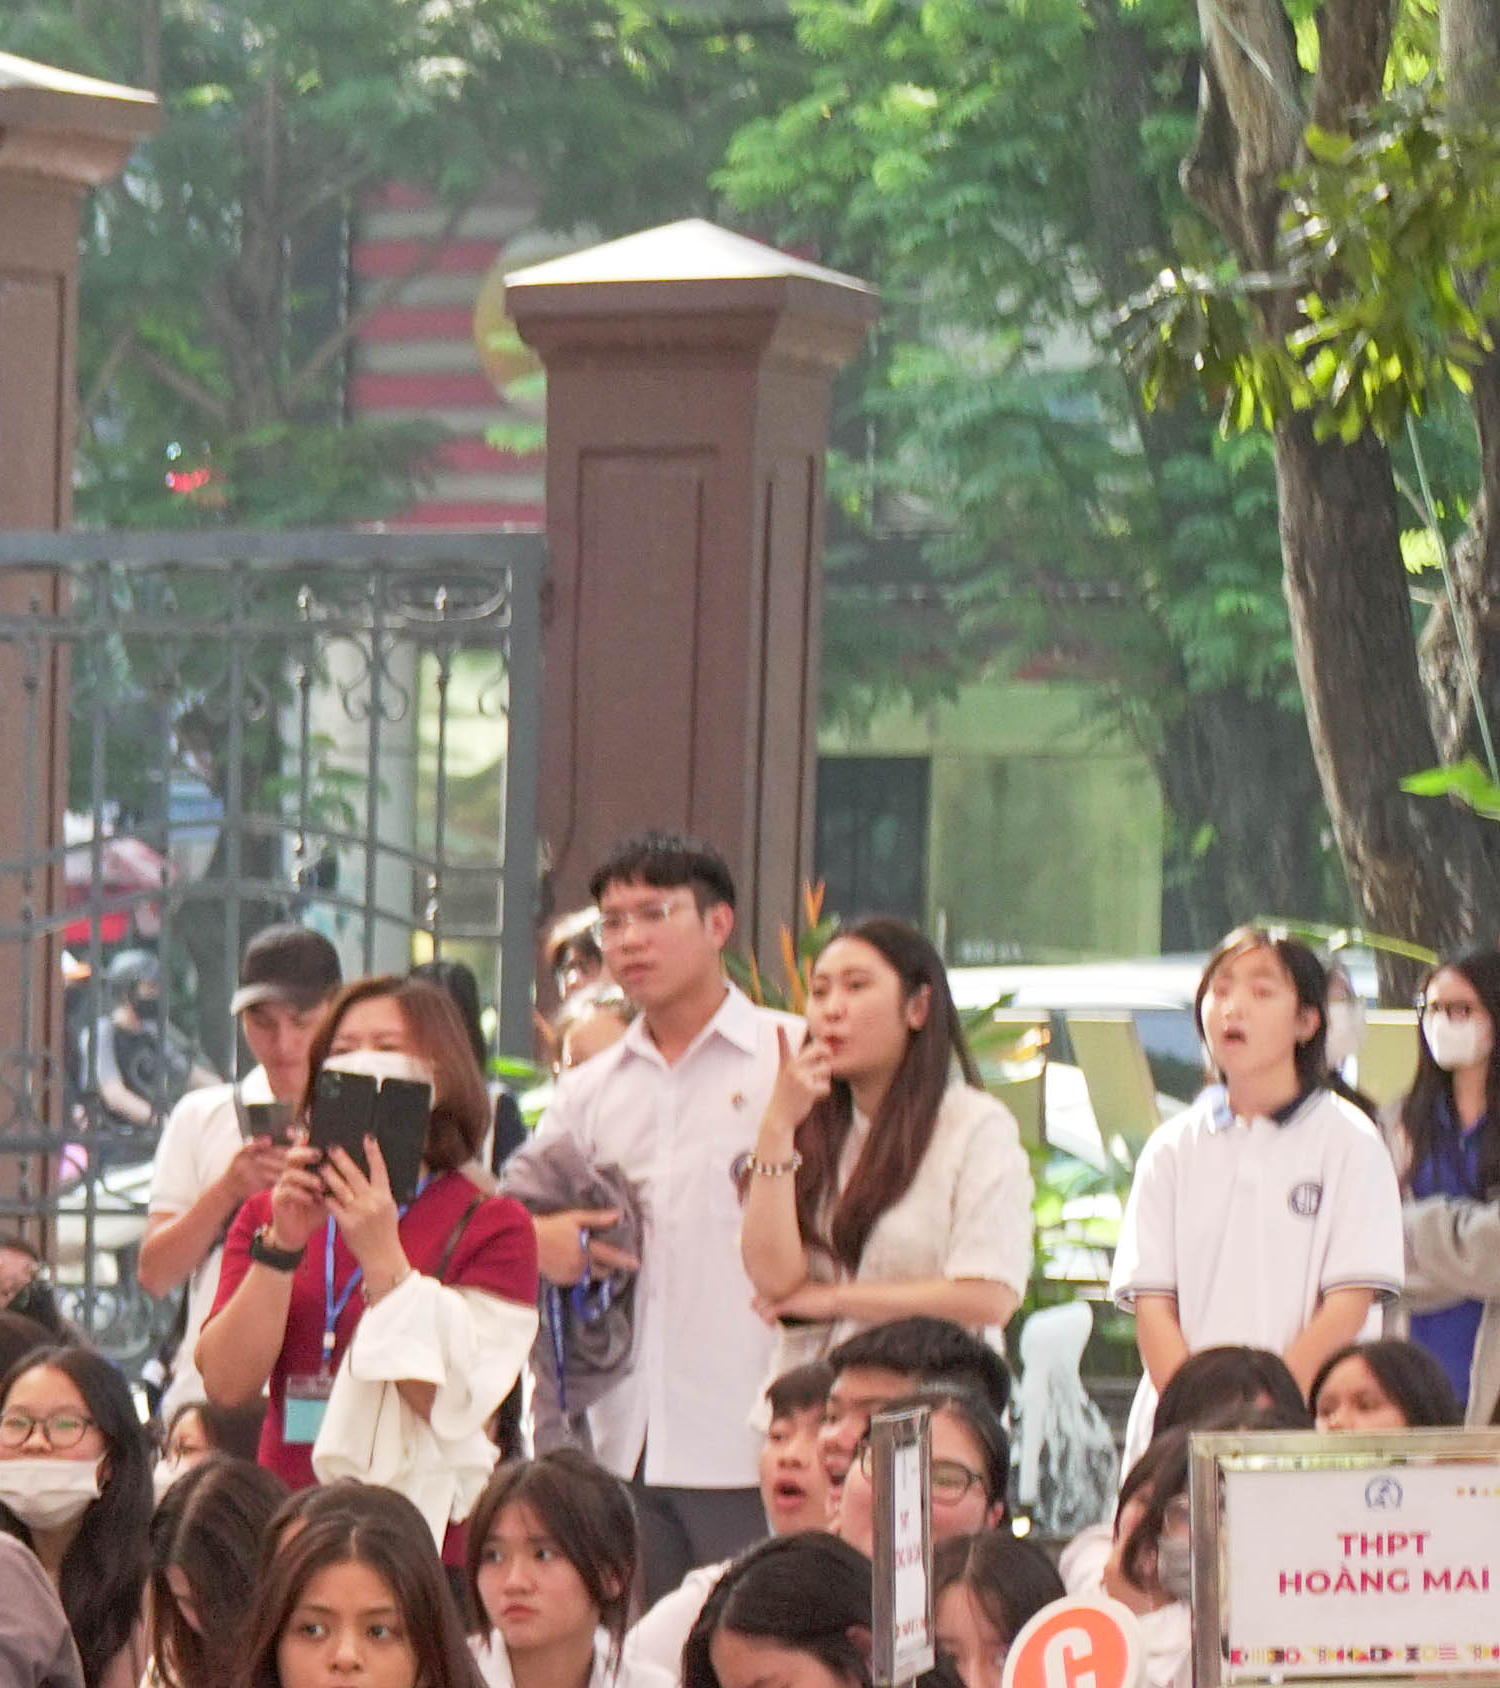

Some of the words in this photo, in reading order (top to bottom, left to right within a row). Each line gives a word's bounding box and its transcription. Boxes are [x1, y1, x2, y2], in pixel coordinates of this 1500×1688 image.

[1337, 1531, 1430, 1557] THPT
[1278, 1563, 1410, 1595] HOÀNG
[1423, 1568, 1490, 1592] MAI
